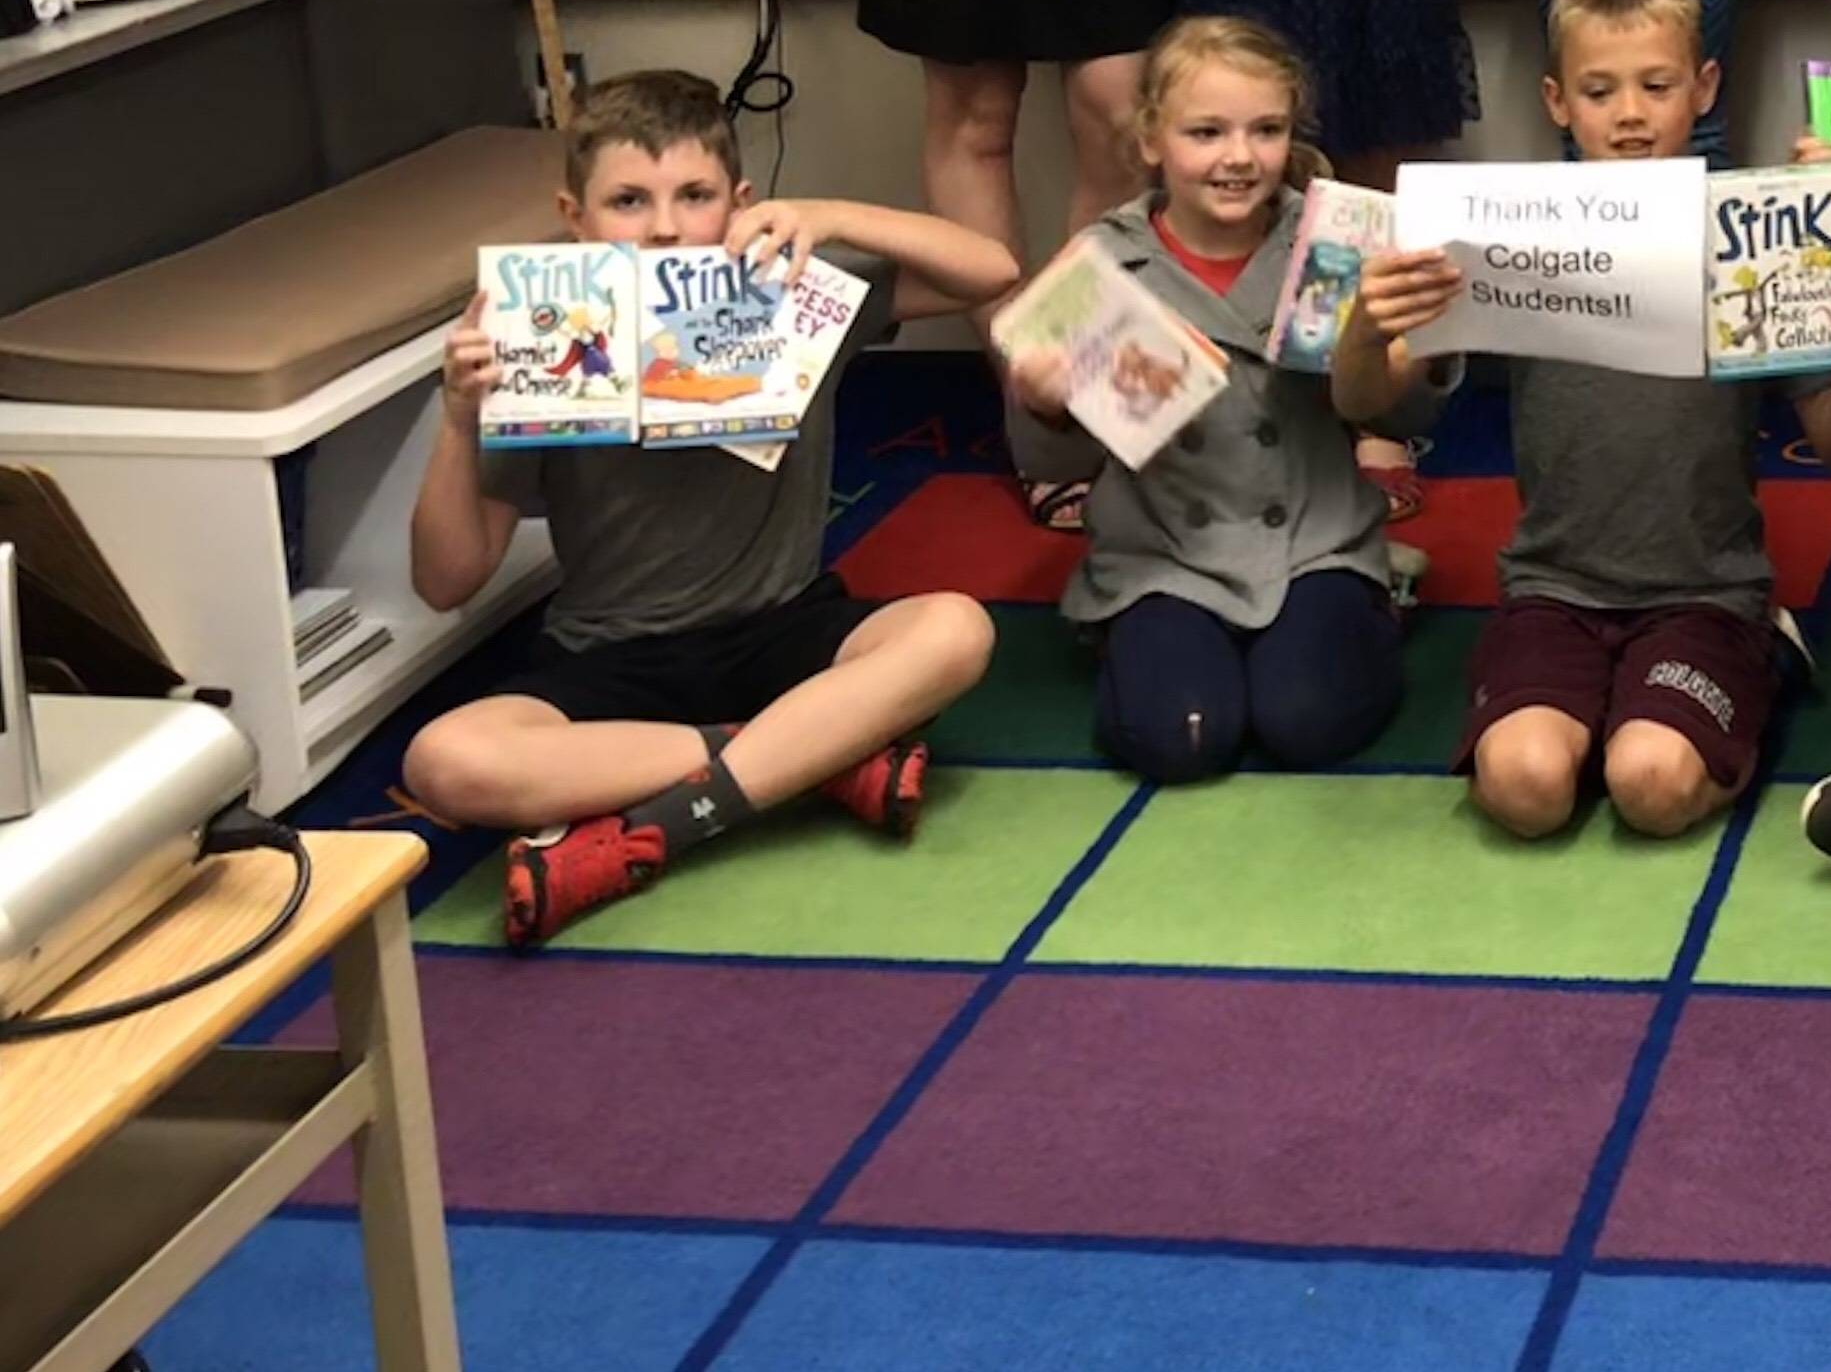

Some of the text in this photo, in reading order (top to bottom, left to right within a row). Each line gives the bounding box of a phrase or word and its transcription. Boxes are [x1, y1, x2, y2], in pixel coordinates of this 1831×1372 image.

[1464, 194, 1641, 224] Thank You
[496, 248, 615, 312] Stink
[1484, 245, 1614, 278] Colgate
[653, 249, 777, 315] Stink
[1471, 280, 1633, 320] Students!!
